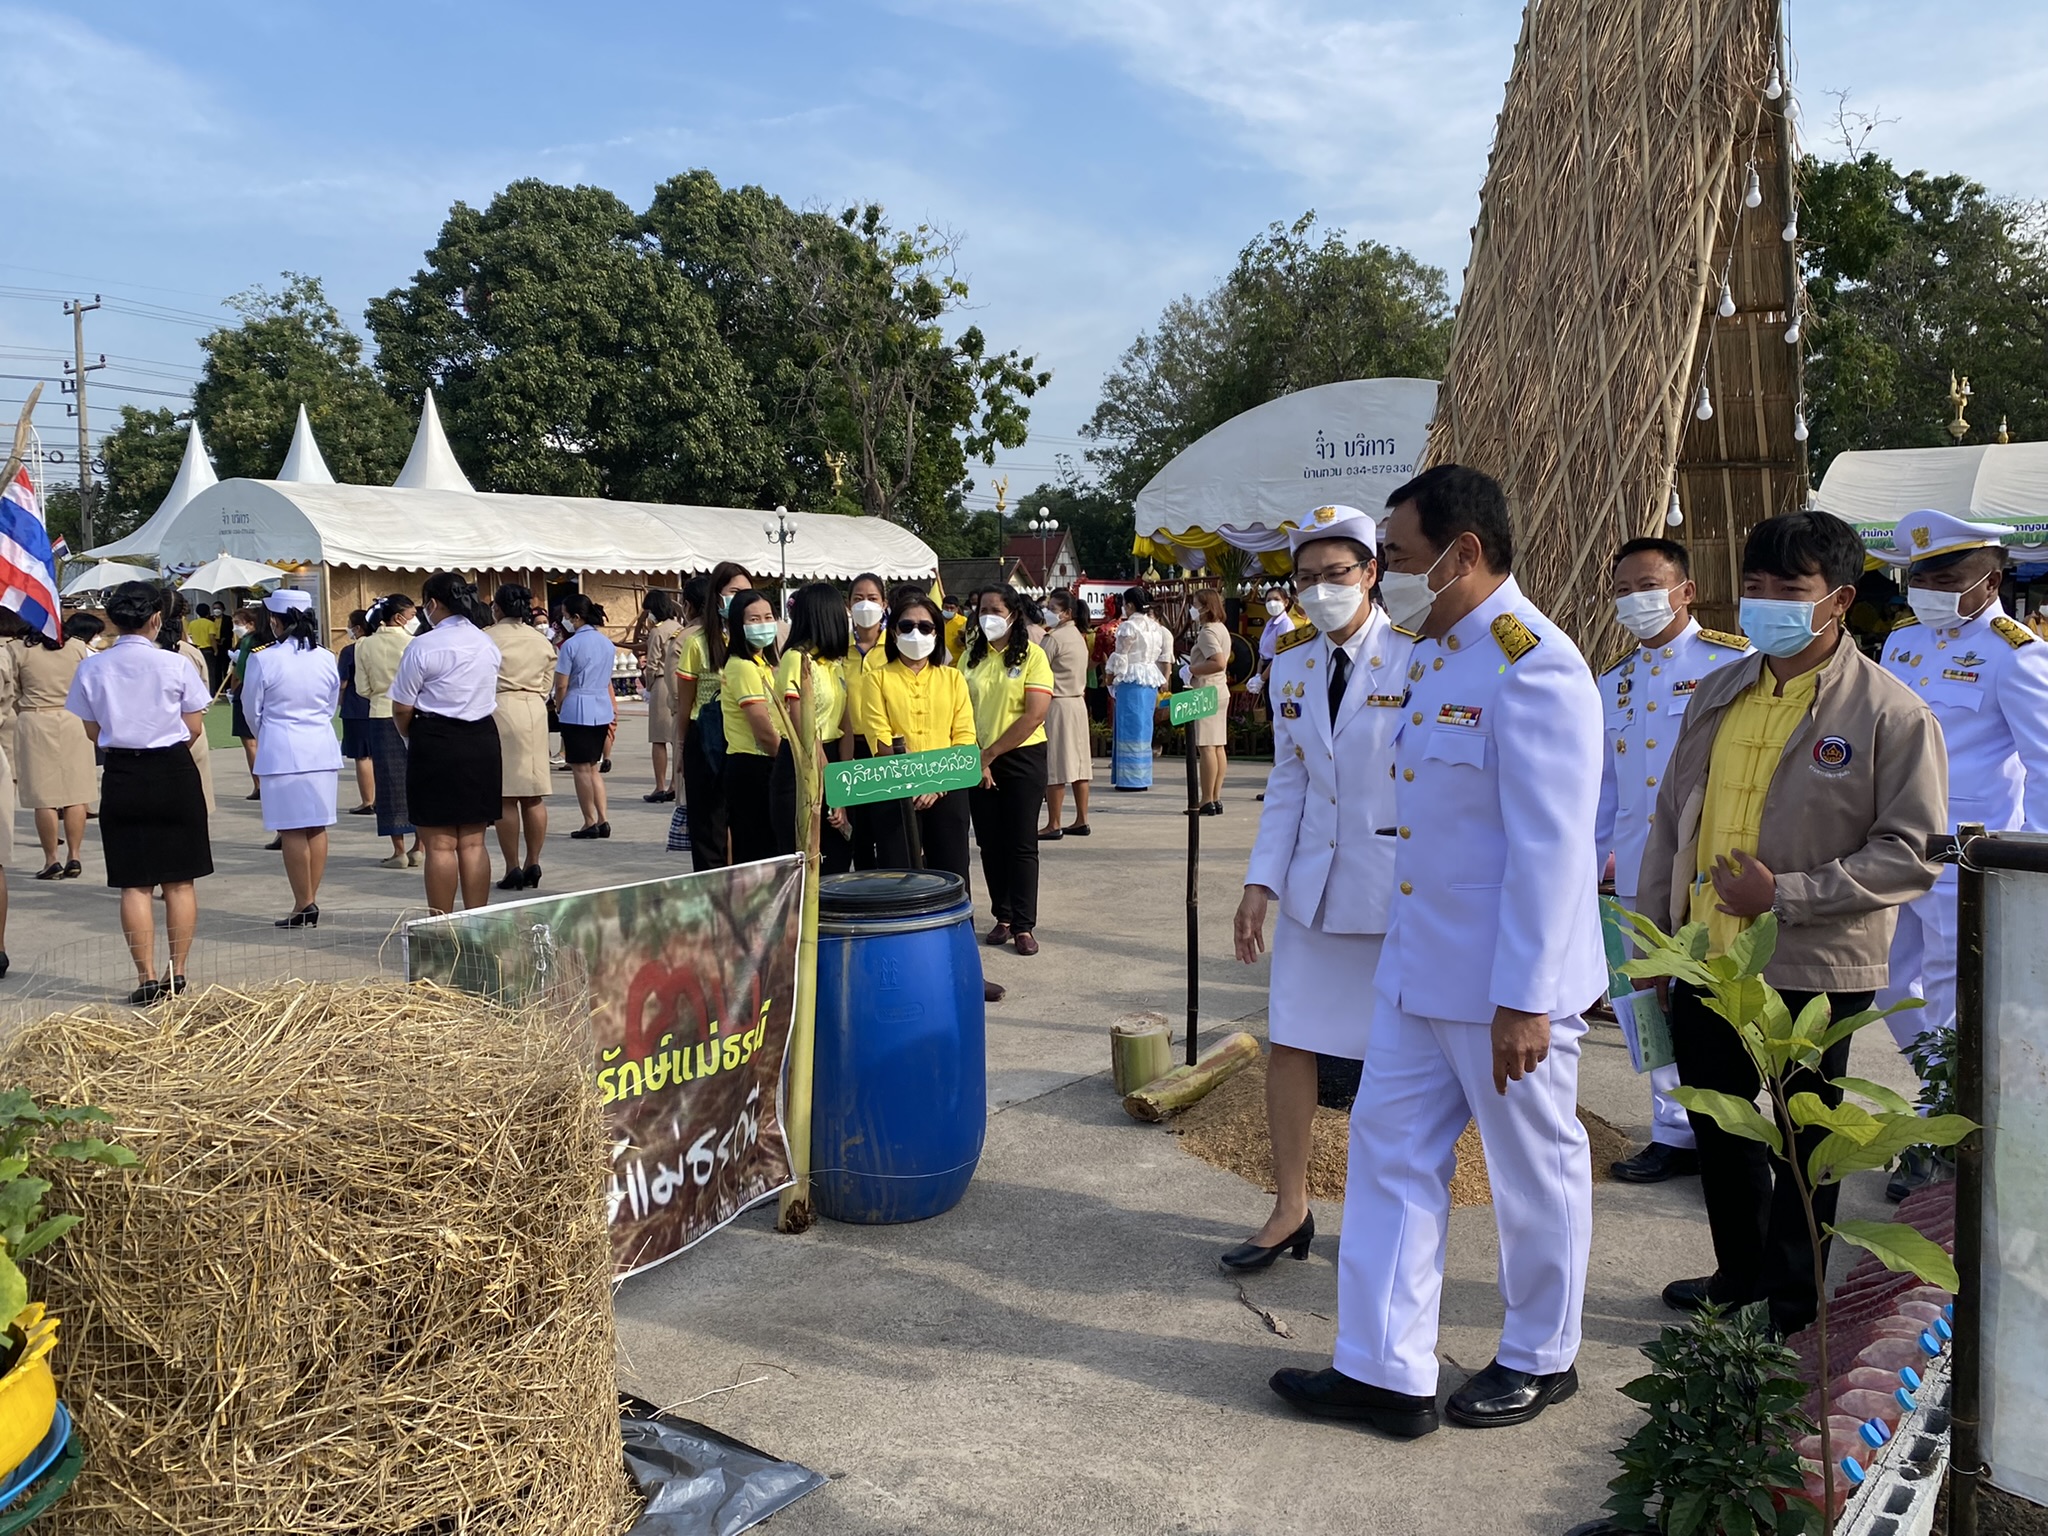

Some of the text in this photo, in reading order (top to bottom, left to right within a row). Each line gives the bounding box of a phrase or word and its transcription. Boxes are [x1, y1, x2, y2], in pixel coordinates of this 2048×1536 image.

[1344, 433, 1395, 458] บริการ
[1303, 464, 1413, 479] บ้านทวน 034-579330
